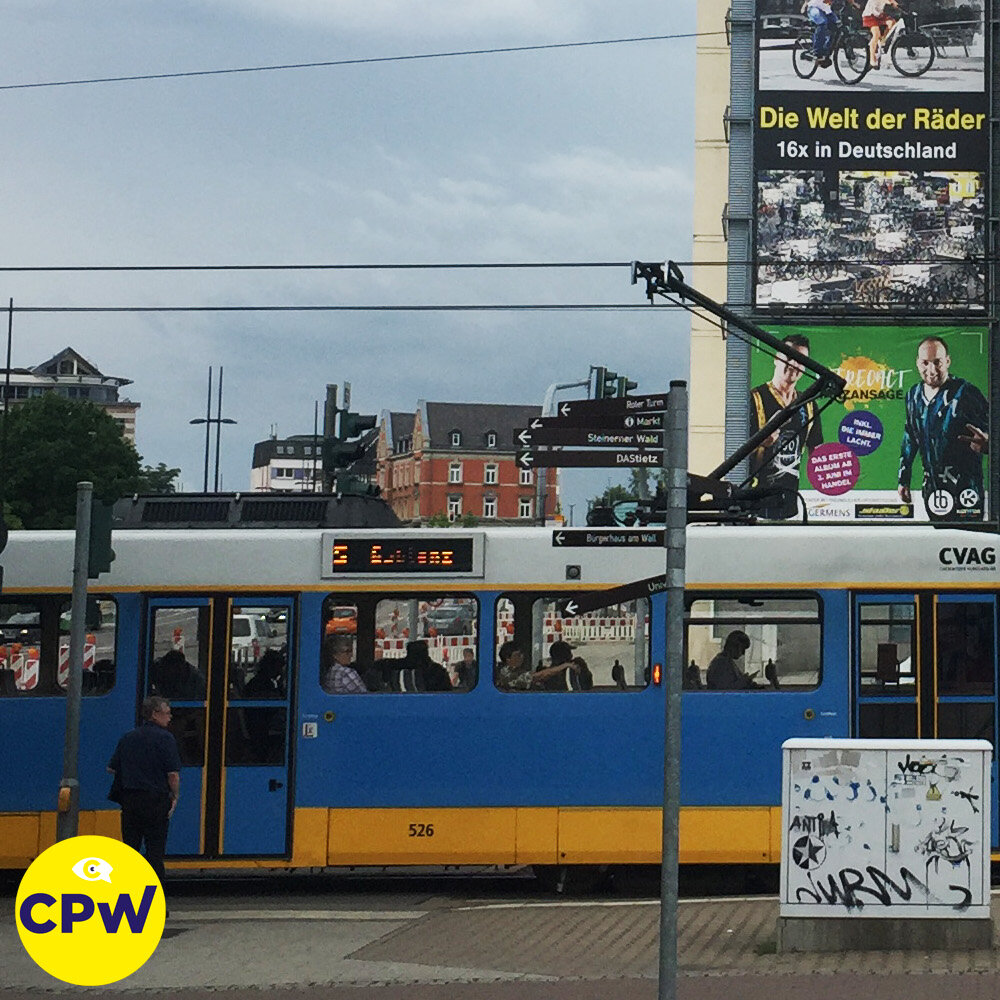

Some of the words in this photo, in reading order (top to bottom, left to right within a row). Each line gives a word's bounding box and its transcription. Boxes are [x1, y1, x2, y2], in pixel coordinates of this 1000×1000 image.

[760, 106, 799, 128] Die
[807, 107, 859, 129] Welt
[867, 108, 906, 130] der
[914, 108, 985, 130] Räder
[777, 141, 808, 158] 16x
[815, 141, 831, 158] in
[838, 142, 957, 159] Deutschland
[637, 417, 660, 425] Markt
[588, 434, 633, 443] Steinerner
[637, 434, 658, 443] Wald
[939, 547, 996, 564] CVAG
[409, 824, 434, 836] 526
